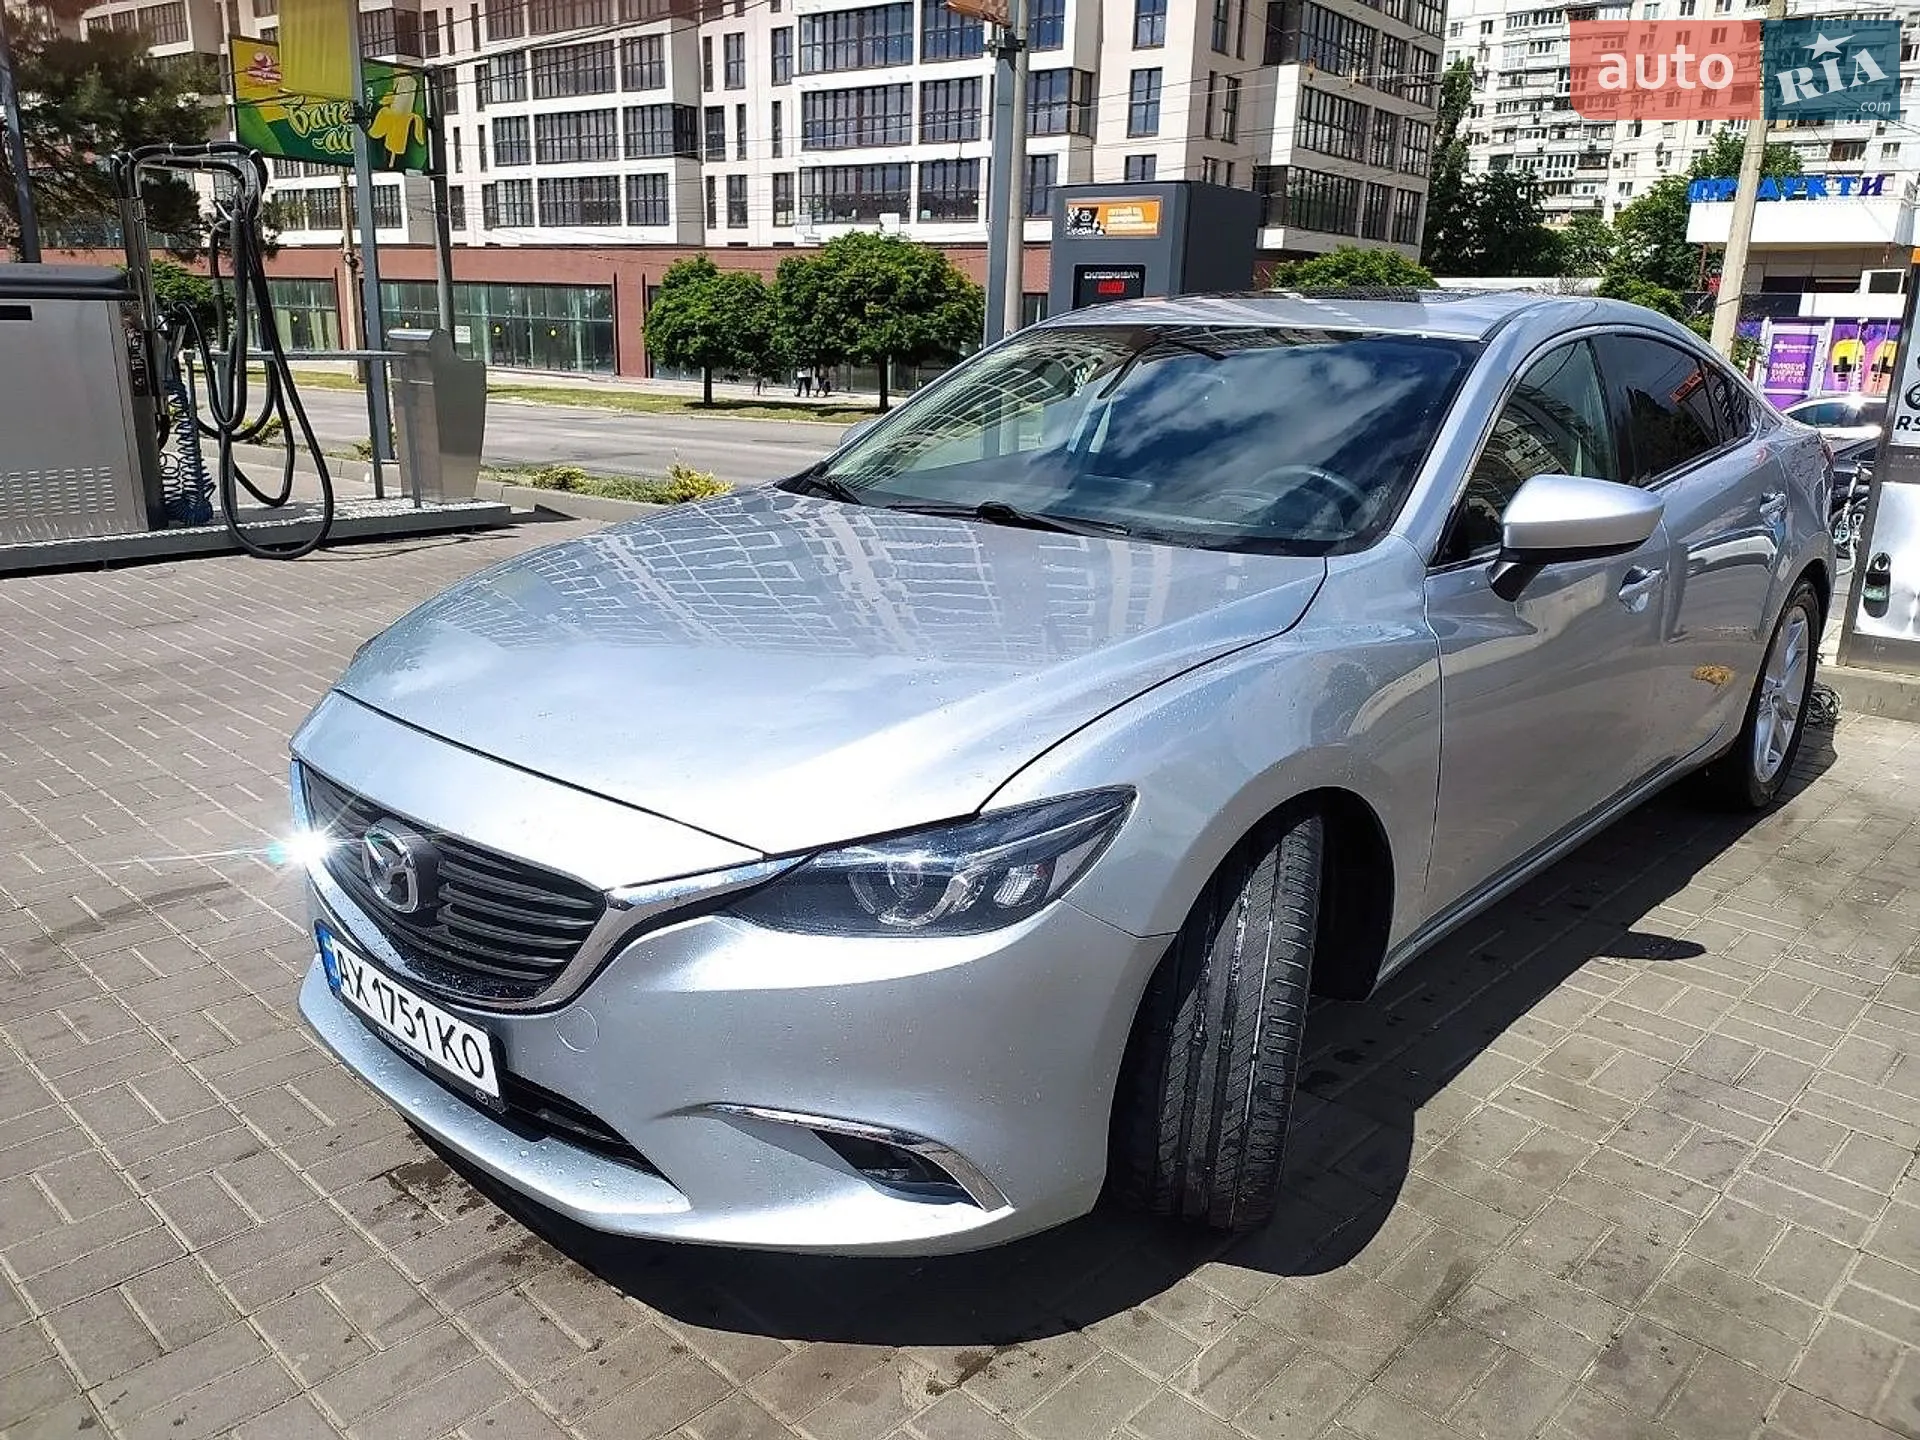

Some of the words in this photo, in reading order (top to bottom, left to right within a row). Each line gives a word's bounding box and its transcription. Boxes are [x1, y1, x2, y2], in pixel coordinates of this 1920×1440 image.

[1687, 175, 1886, 201] ПРДУКТИ
[337, 948, 370, 1008] AX
[372, 977, 432, 1050] 1751
[436, 1015, 484, 1079] KO
